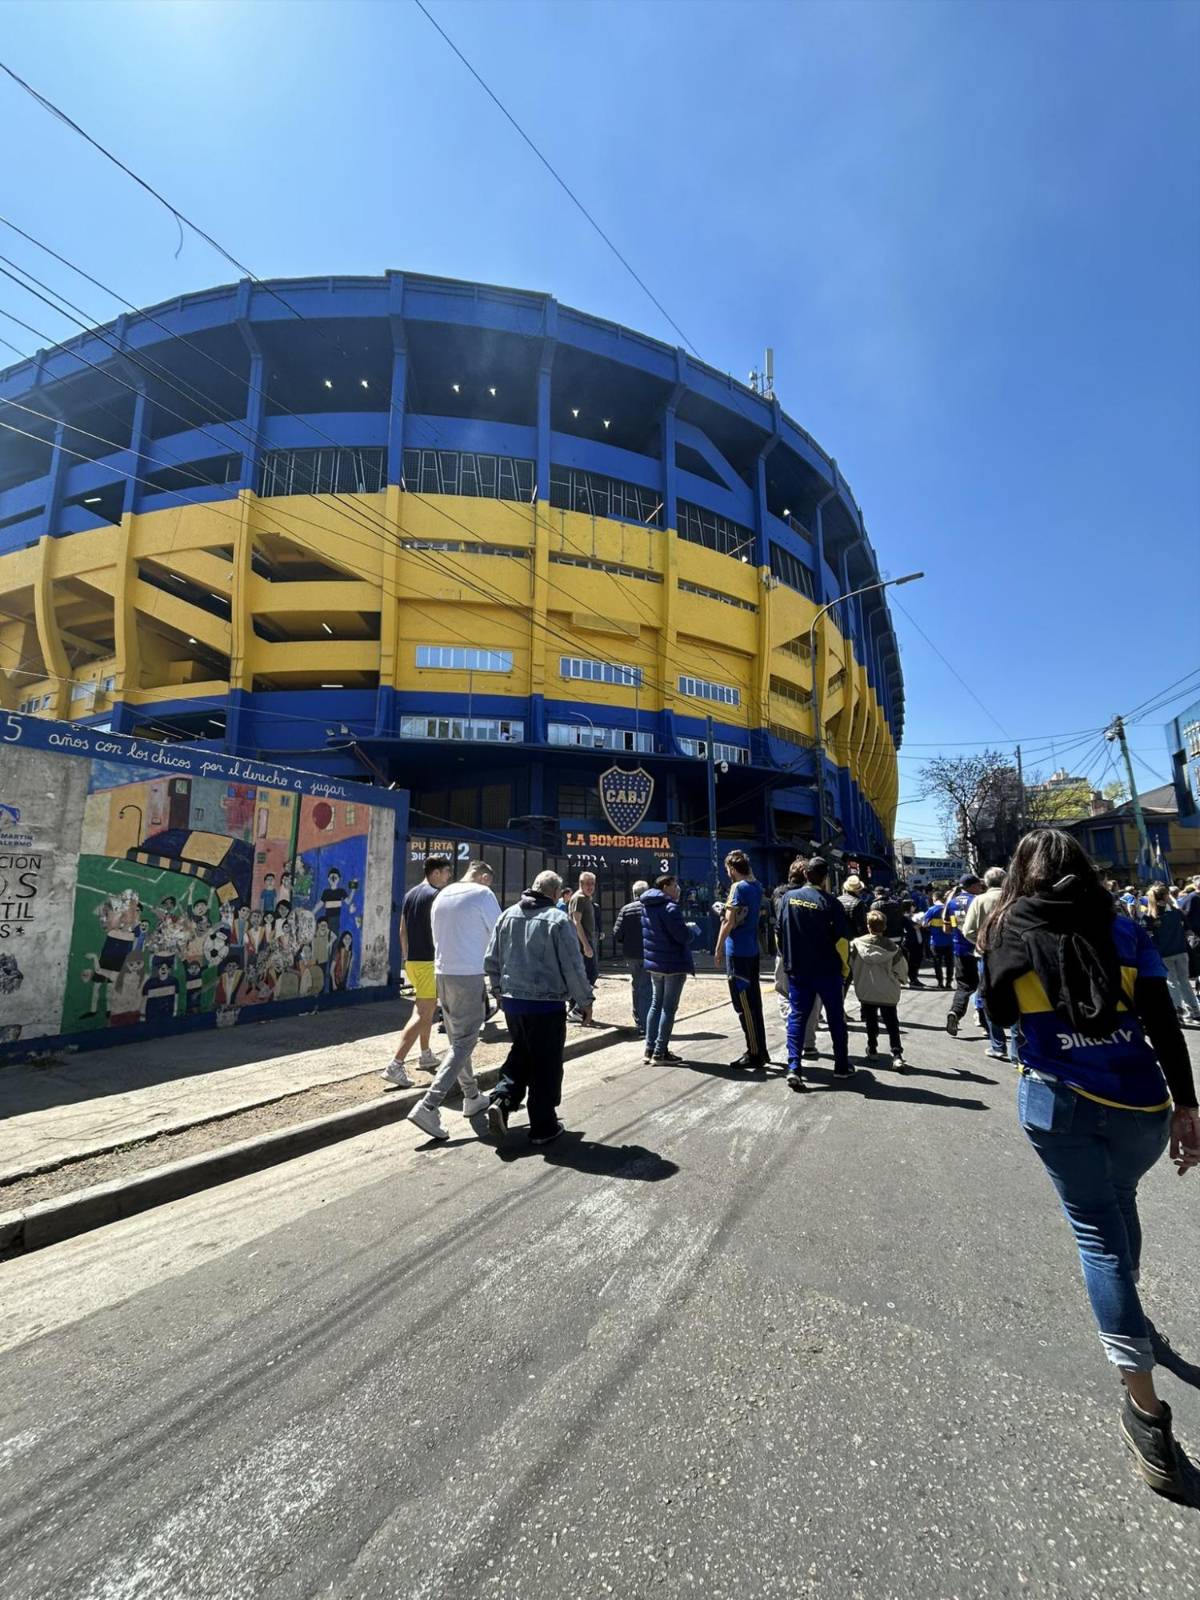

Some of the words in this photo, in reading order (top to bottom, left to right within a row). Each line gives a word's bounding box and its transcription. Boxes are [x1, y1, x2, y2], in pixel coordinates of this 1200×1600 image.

[49, 733, 89, 750] años
[95, 740, 122, 755] con
[126, 742, 149, 761] los
[151, 749, 192, 769] chicos
[200, 761, 225, 776] por
[228, 761, 240, 777] el
[243, 765, 288, 786] derecho
[294, 780, 302, 789] a
[606, 790, 647, 804] CABJ
[566, 833, 586, 846] LA
[589, 834, 671, 849] BOMBONERA
[457, 842, 470, 860] 2
[660, 859, 669, 873] 3
[0, 902, 34, 919] TIL
